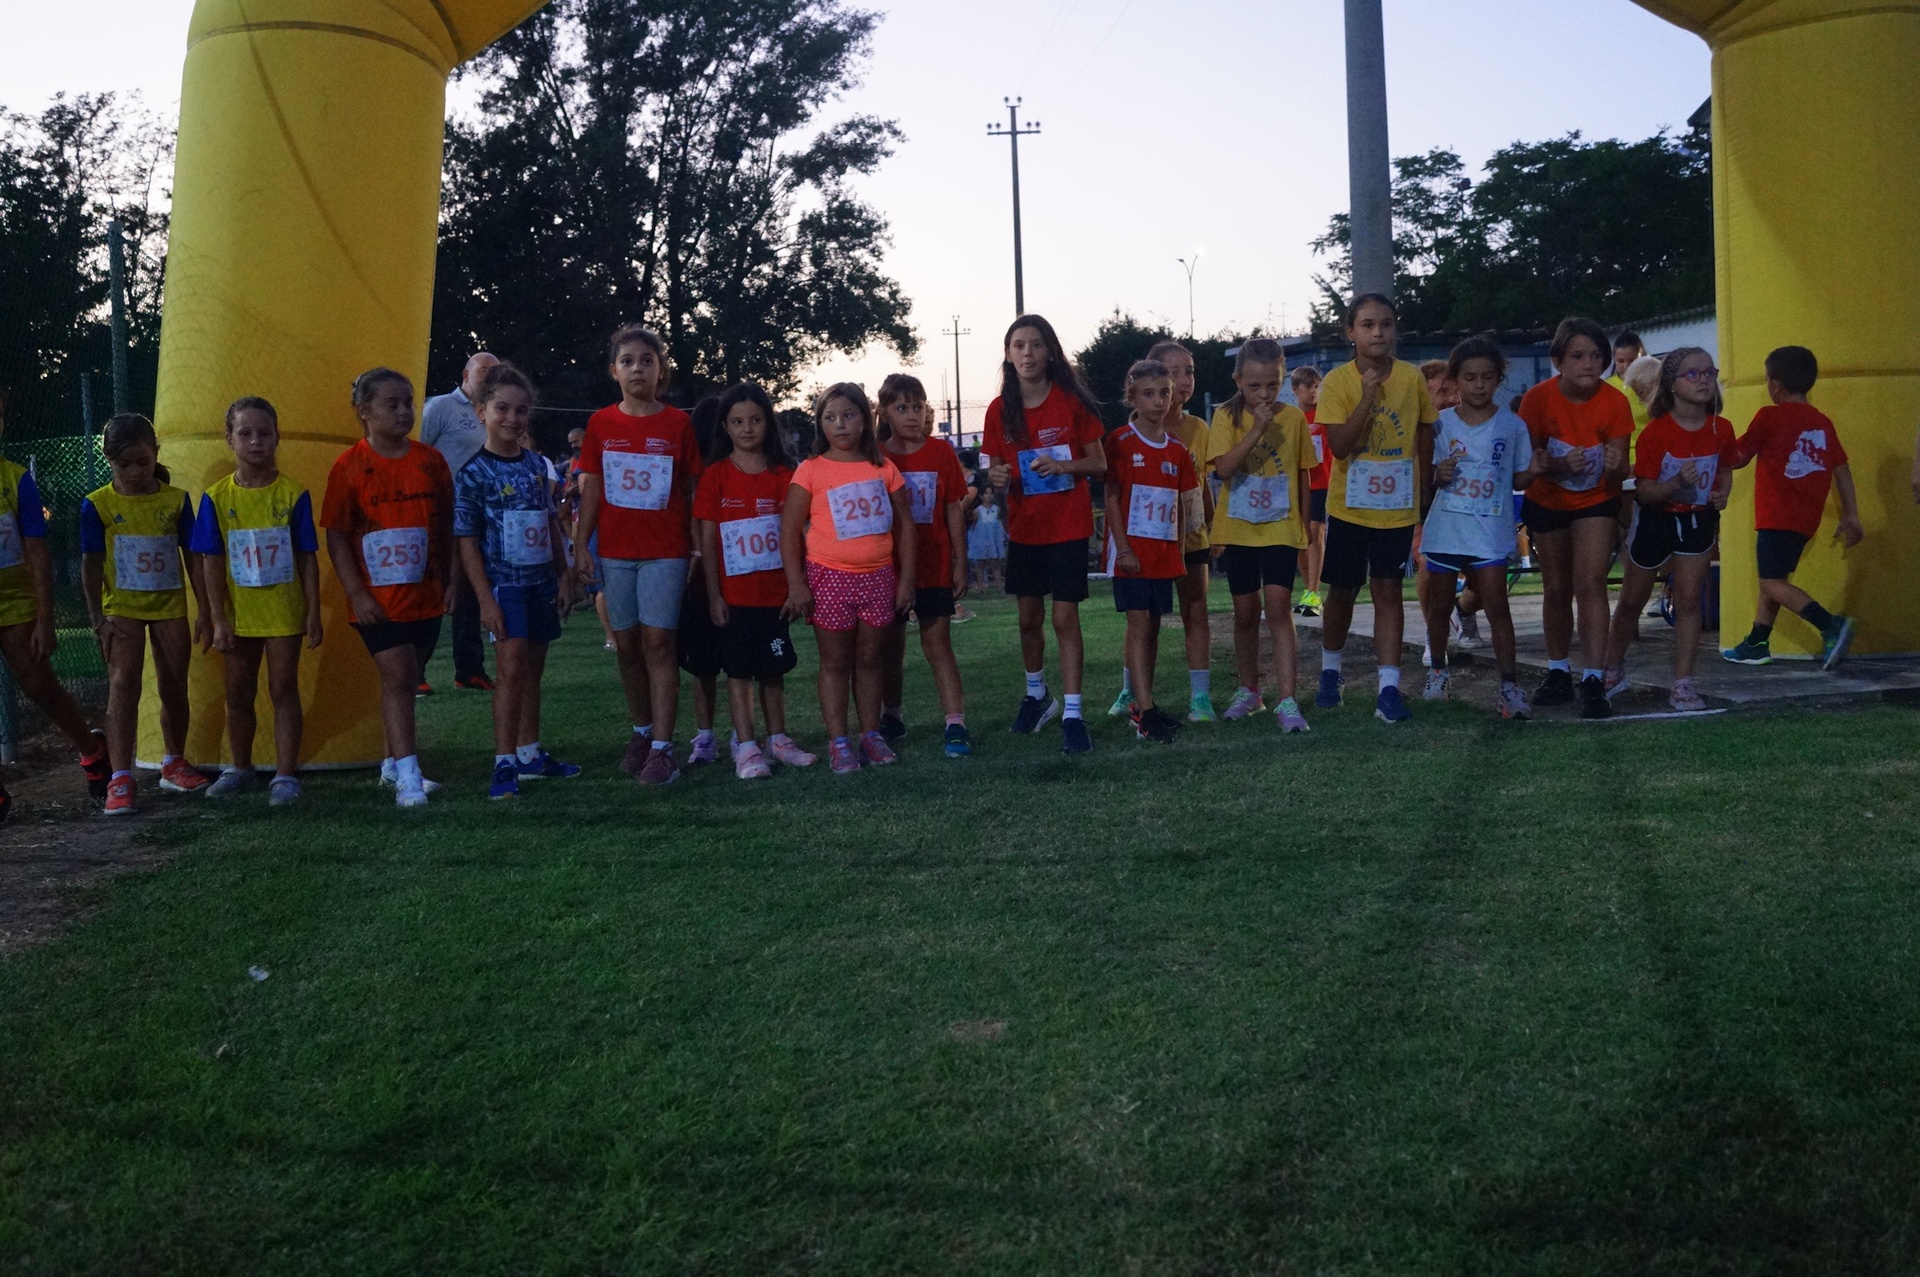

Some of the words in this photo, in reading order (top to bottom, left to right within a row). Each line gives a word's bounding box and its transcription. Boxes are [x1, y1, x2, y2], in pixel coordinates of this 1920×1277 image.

[1585, 459, 1596, 476] 2
[621, 469, 651, 492] 53
[1368, 475, 1396, 494] 59
[1452, 476, 1495, 499] 259
[1699, 470, 1709, 490] 0
[906, 487, 926, 507] 11
[1248, 490, 1272, 509] 58
[843, 495, 884, 521] 292
[1144, 501, 1176, 524] 116
[0, 529, 14, 550] 7
[525, 527, 548, 547] 92
[735, 531, 778, 556] 106
[137, 552, 165, 573] 55
[242, 545, 279, 568] 117
[378, 544, 420, 568] 253
